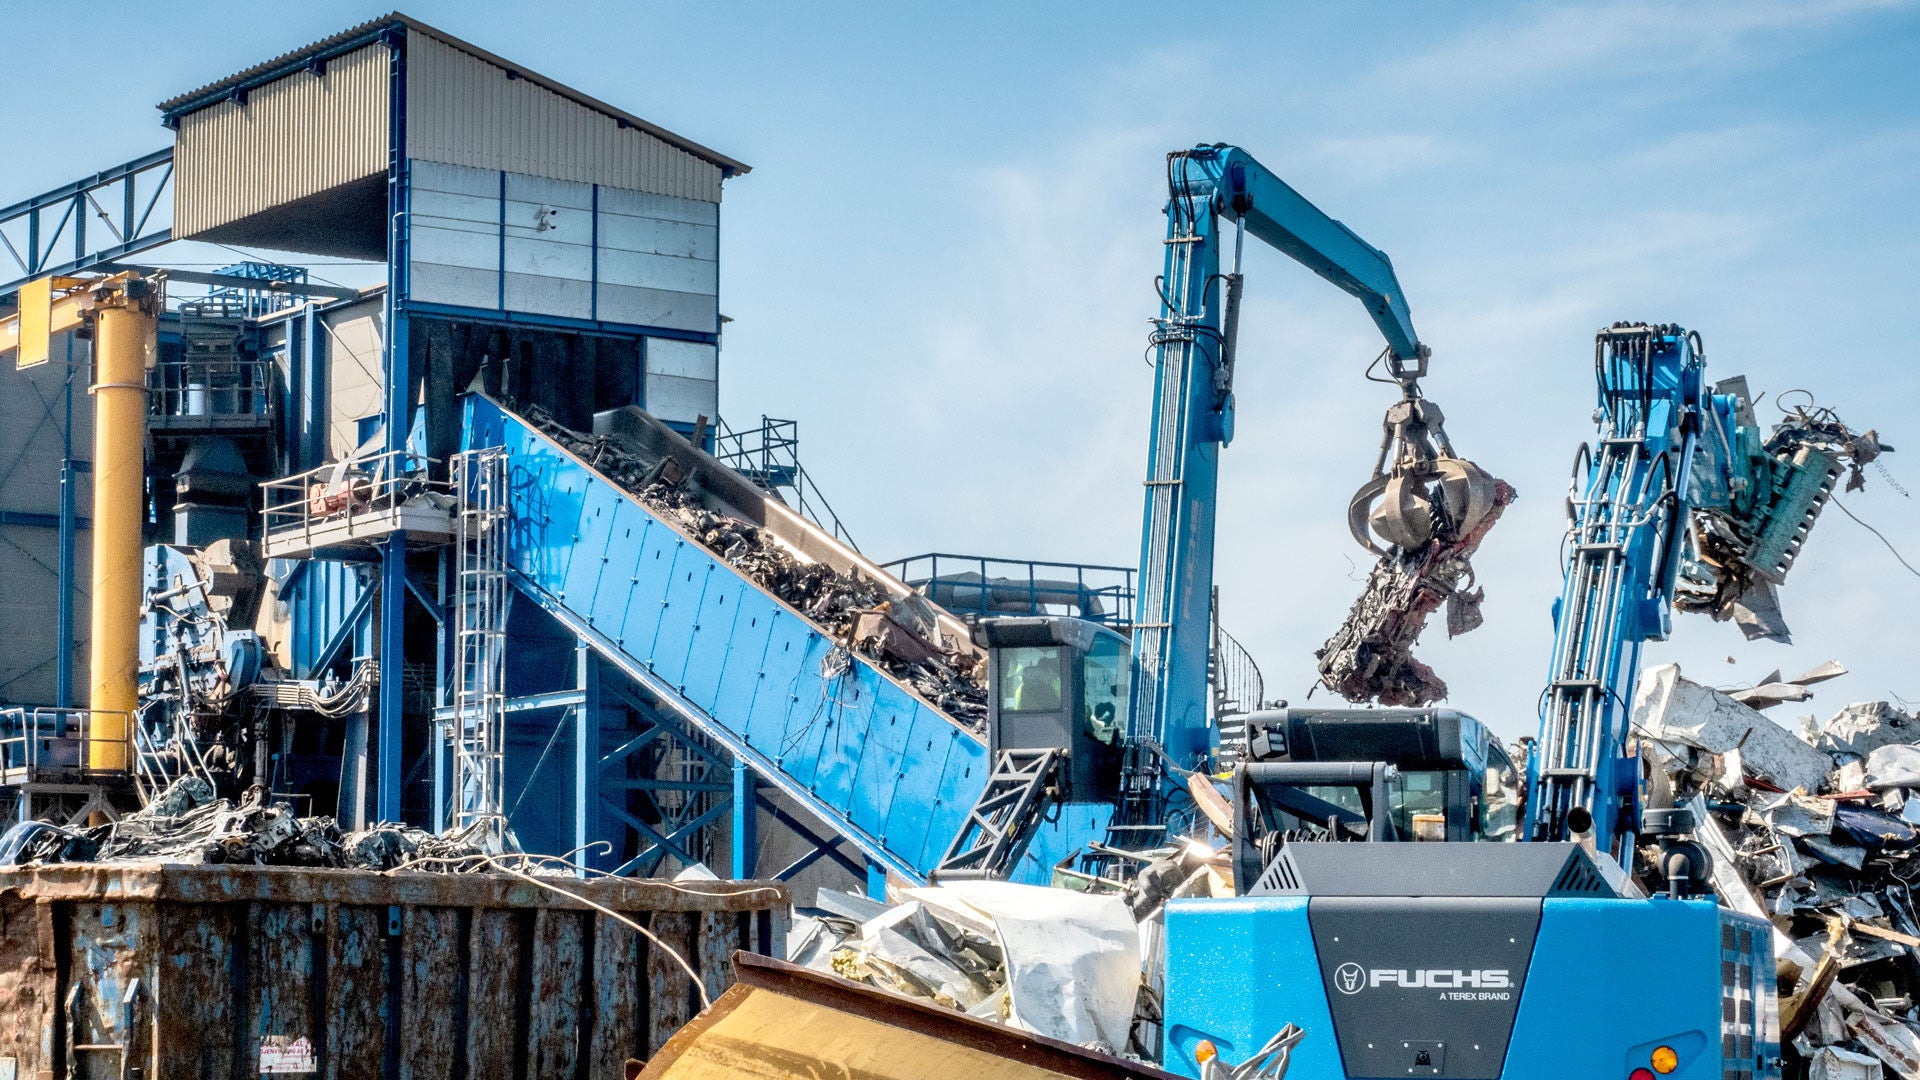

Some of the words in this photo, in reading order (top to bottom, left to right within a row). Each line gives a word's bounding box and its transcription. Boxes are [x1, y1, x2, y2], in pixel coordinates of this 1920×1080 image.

[1370, 969, 1509, 988] FUCHS
[1439, 992, 1447, 1001] A
[1448, 992, 1477, 1001] TEREX
[1478, 992, 1510, 1001] BRAND
